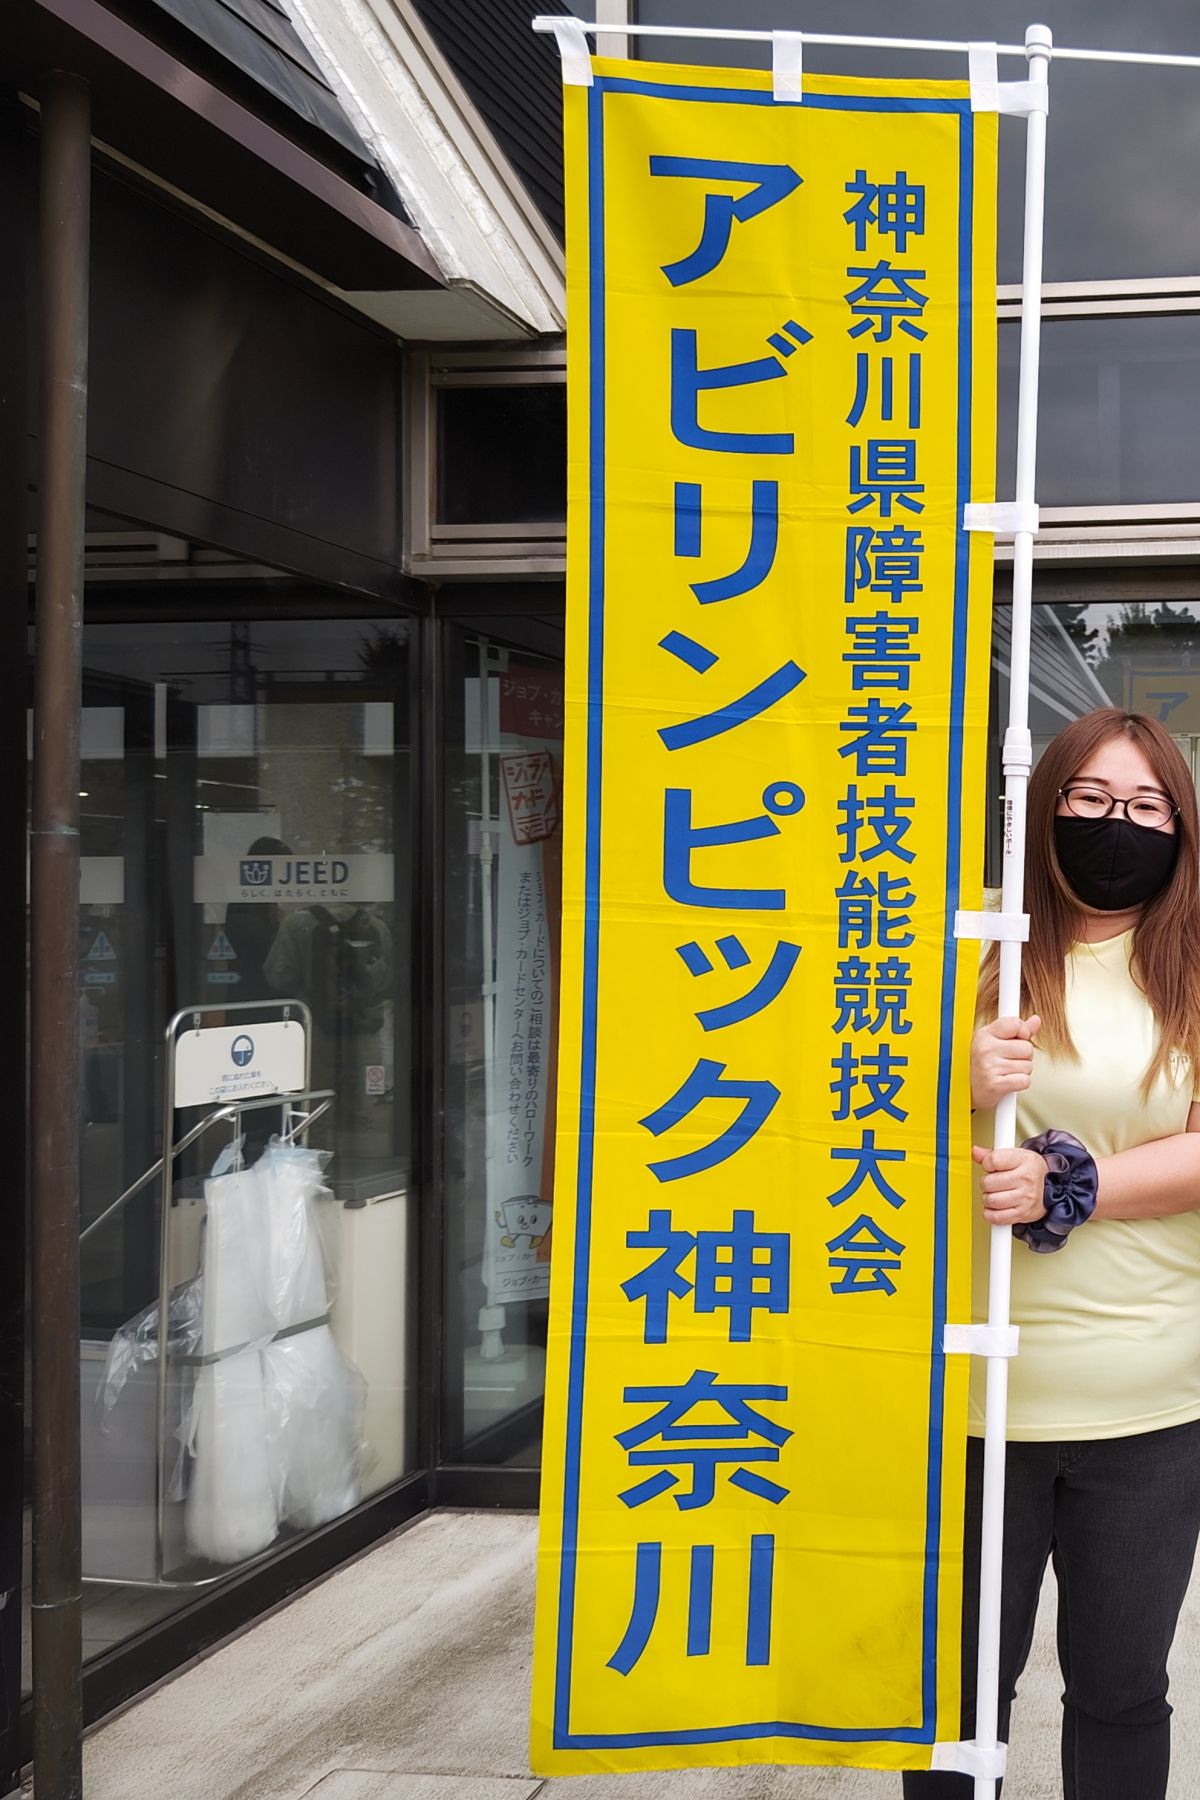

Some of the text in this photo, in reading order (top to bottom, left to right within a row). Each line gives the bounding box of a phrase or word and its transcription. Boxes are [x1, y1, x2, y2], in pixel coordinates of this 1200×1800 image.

[278, 861, 350, 885] JEED
[606, 154, 813, 1677] アビリンピック神奈川
[826, 170, 929, 1298] 神奈川県障害者技能競技大会
